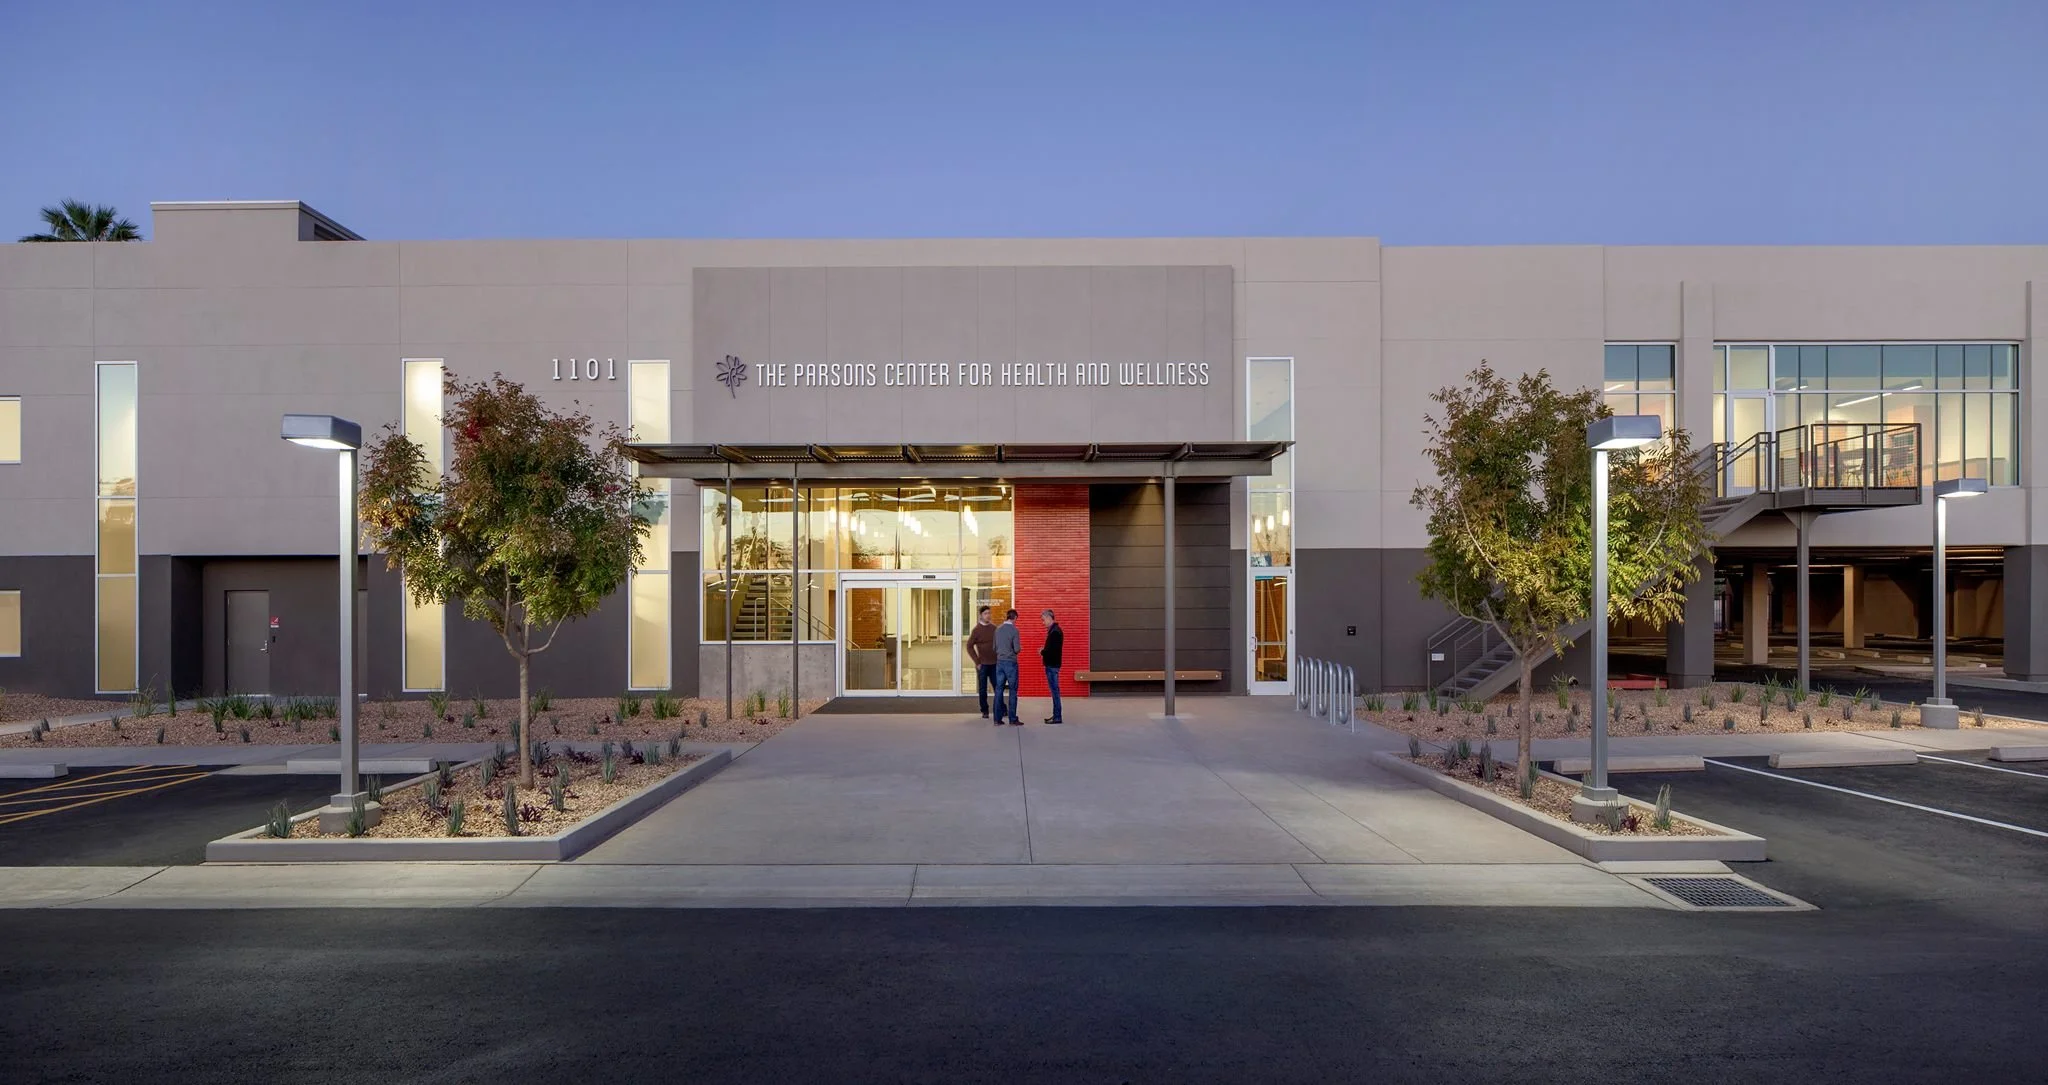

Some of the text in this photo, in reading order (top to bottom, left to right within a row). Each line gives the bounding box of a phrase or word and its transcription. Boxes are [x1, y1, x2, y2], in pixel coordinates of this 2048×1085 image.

[552, 358, 616, 380] 1101
[756, 363, 1209, 386] THE PARSONS CENTER FOR HEALTH AND WELLNESS
